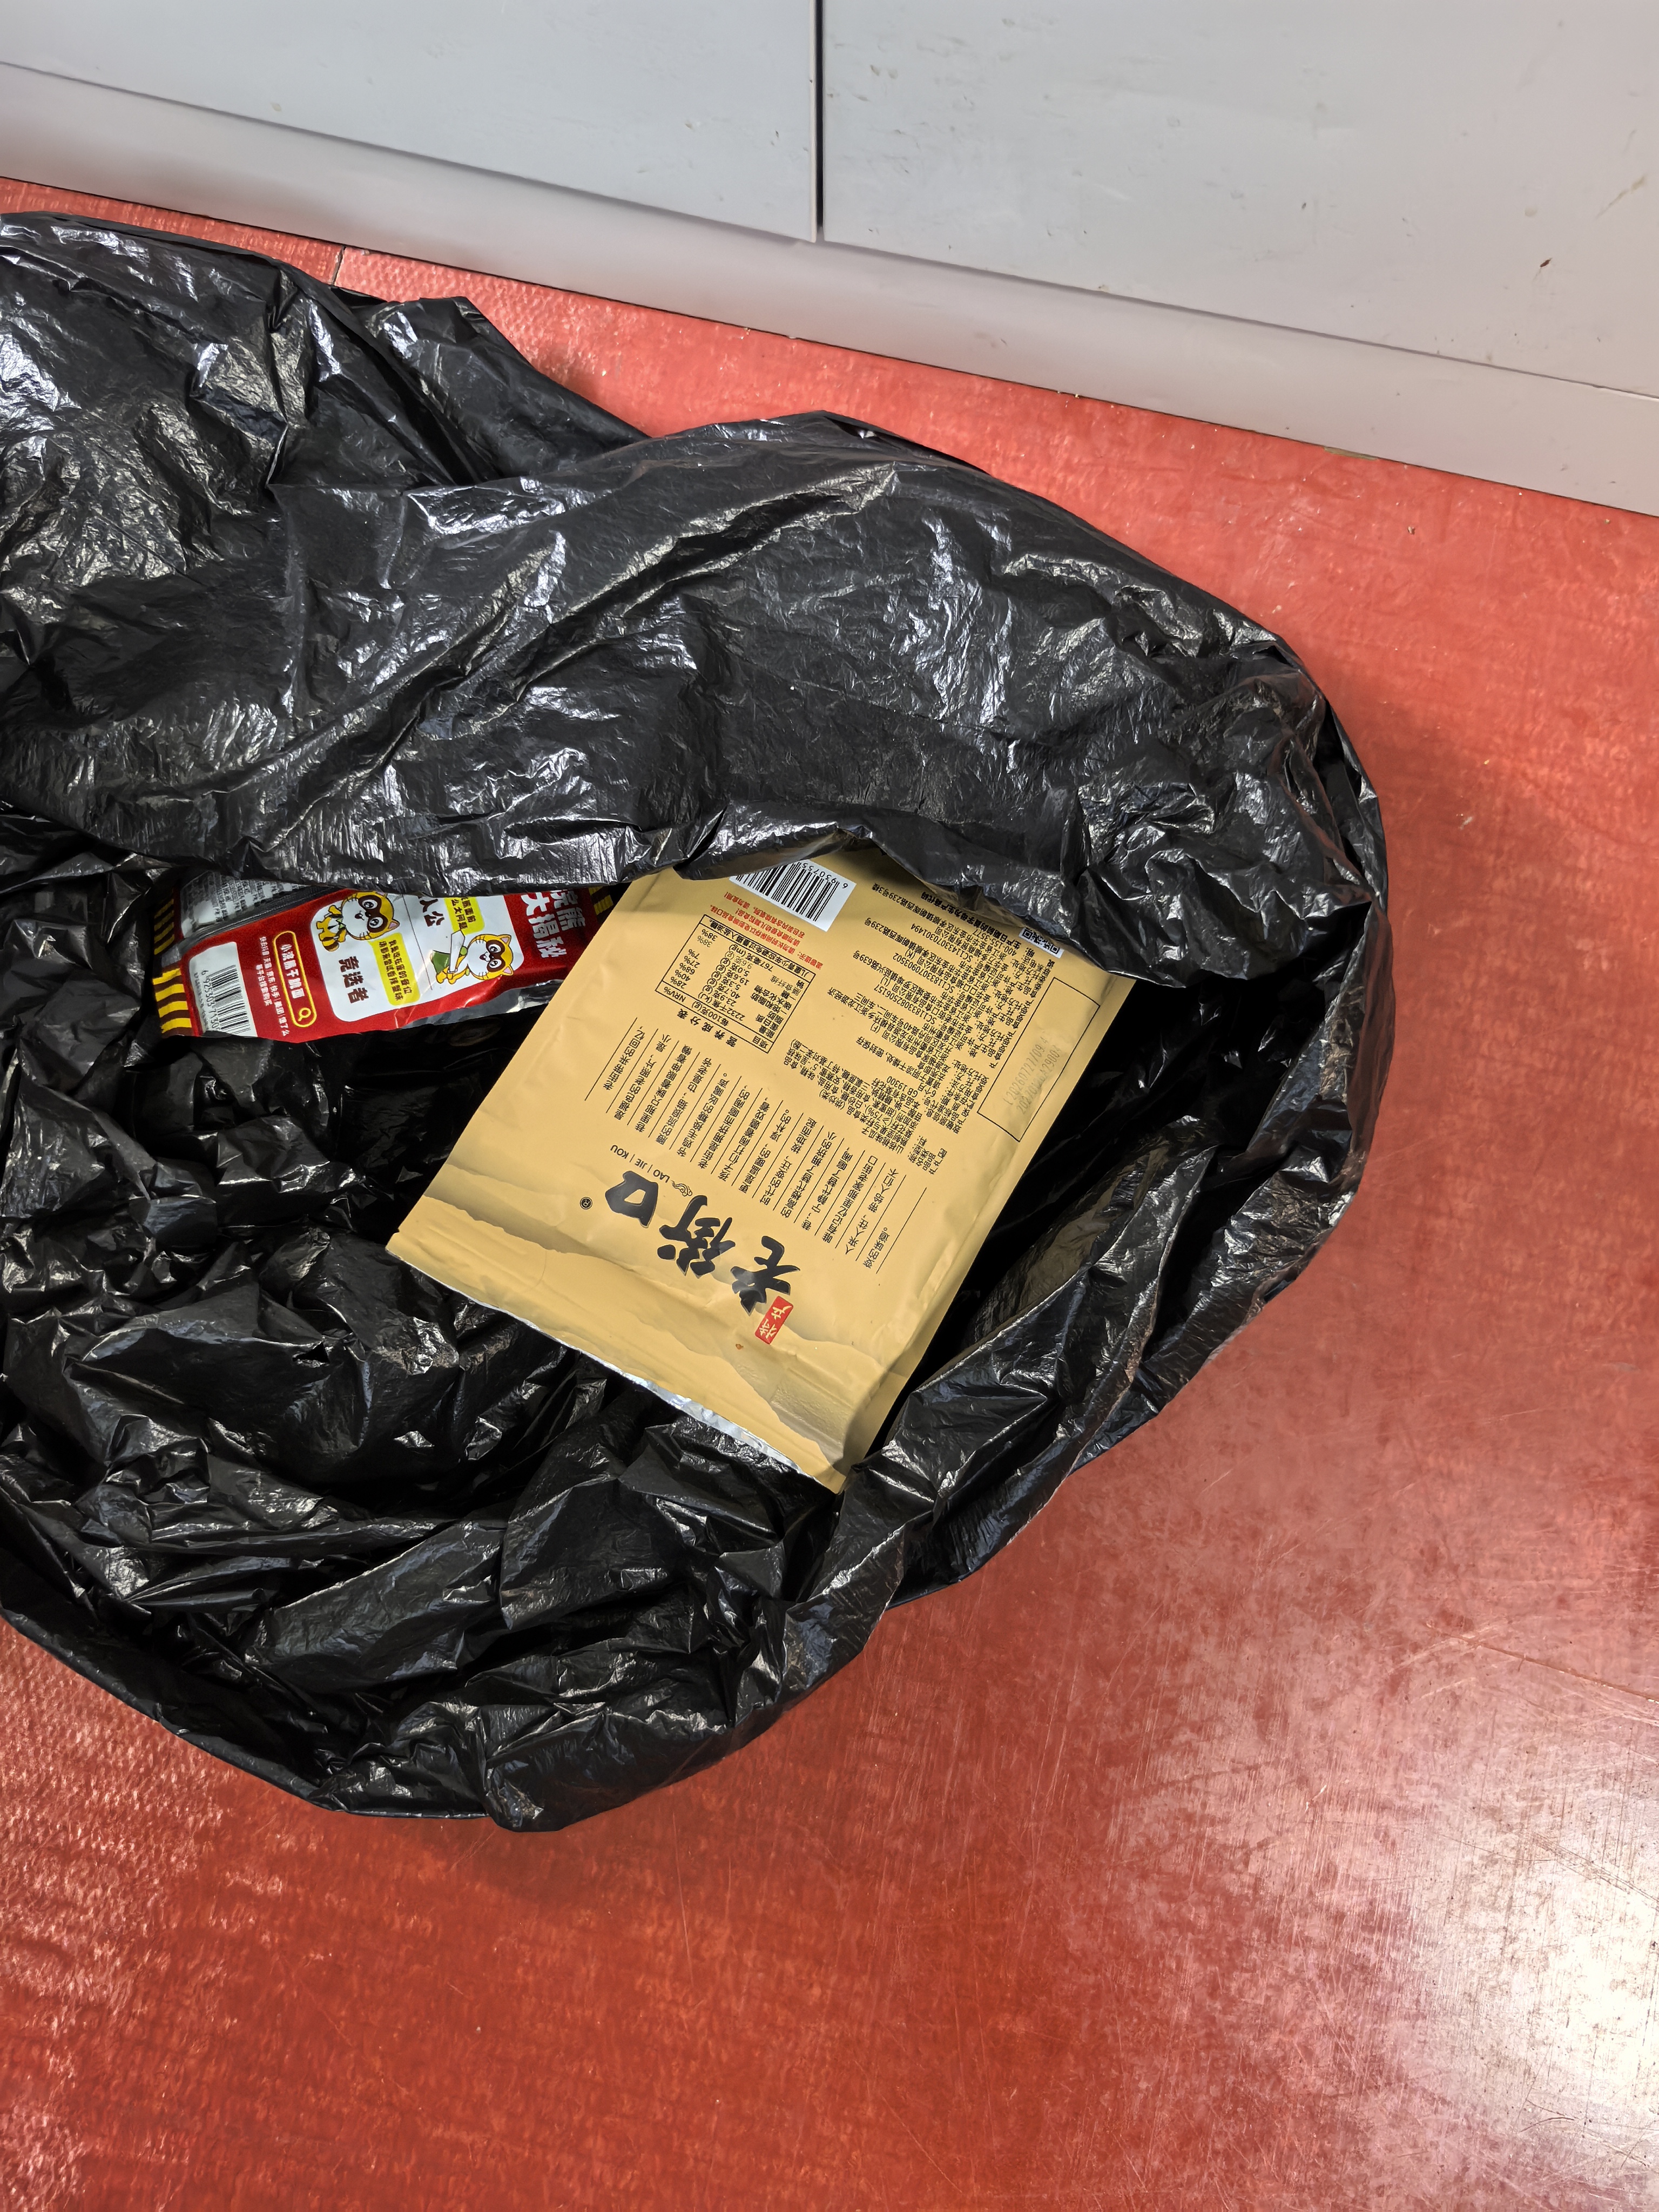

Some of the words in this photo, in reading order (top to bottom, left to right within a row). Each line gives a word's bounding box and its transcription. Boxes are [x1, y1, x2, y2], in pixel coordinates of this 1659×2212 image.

[417, 894, 444, 927] 人公
[521, 892, 567, 958] 大揭秘
[697, 935, 713, 948] 38%
[702, 928, 718, 942] 38%
[911, 923, 974, 963] SC11433070301494
[972, 926, 1017, 956] 400-155-3577
[684, 955, 700, 968] 27%
[688, 949, 700, 960] 7%
[280, 944, 305, 999] 小浣熊干脆面
[675, 969, 691, 981] 40%
[679, 962, 696, 975] 68%
[893, 952, 955, 994] SC11833070903502
[958, 960, 1001, 988] 浙江省金华市
[338, 956, 369, 1004] 竞选者
[670, 976, 687, 989] 28%
[770, 975, 801, 996] 膳食纤维
[796, 980, 805, 989] 钠
[664, 986, 686, 1003] NRV%
[753, 984, 792, 1011] 碳水化合物
[873, 984, 937, 1025] SC11833082506157
[940, 992, 983, 1020] 浙江省金华市
[755, 1014, 779, 1032] 蛋白质
[766, 1010, 784, 1025] 脂肪
[677, 1008, 738, 1048] 营养成分表
[758, 1024, 775, 1039] 能量
[921, 1023, 965, 1051] 浙江省衢州市
[752, 1035, 769, 1049] 项目
[917, 1061, 946, 1082] 去壳即食
[871, 1077, 921, 1110] 本品含有葵花籽
[886, 1076, 908, 1092] 19300
[907, 1088, 918, 1098] GB
[917, 1082, 936, 1097] 6个月
[861, 1126, 904, 1154] 山核桃味瓜子
[610, 1145, 629, 1159] KOU
[634, 1158, 648, 1169] JIE
[653, 1169, 670, 1183] LAO
[605, 1171, 800, 1313] 老街口
[759, 1305, 792, 1340] 特产
